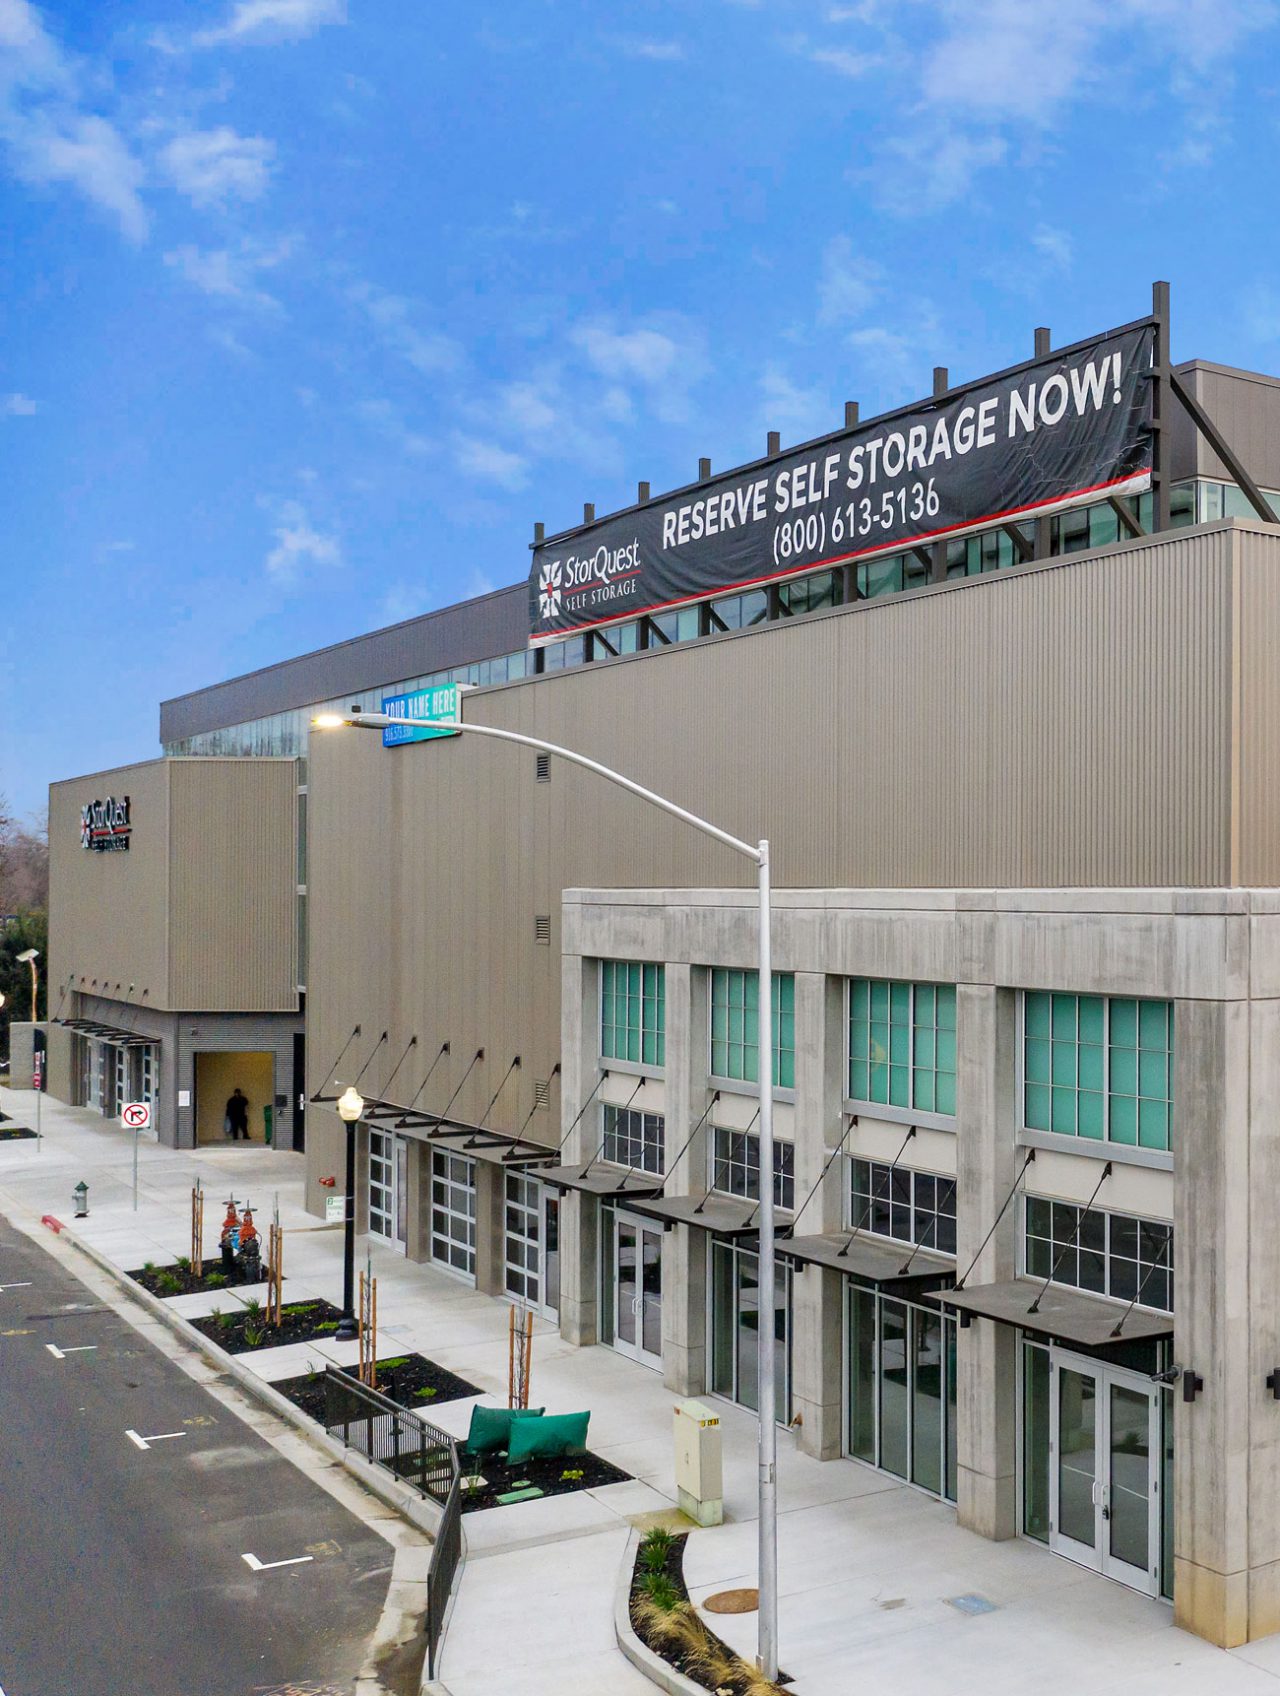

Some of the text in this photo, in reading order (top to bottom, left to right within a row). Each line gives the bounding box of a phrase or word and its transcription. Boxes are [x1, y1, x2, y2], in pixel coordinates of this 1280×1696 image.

[663, 351, 1123, 549] RESERVE SELF STORAGE NOW!
[773, 477, 940, 566] (800) 613-5136
[564, 537, 640, 588] StorQuest
[566, 579, 637, 612] SELF STORAGE
[408, 694, 430, 719] NAME
[433, 688, 455, 715] HERE
